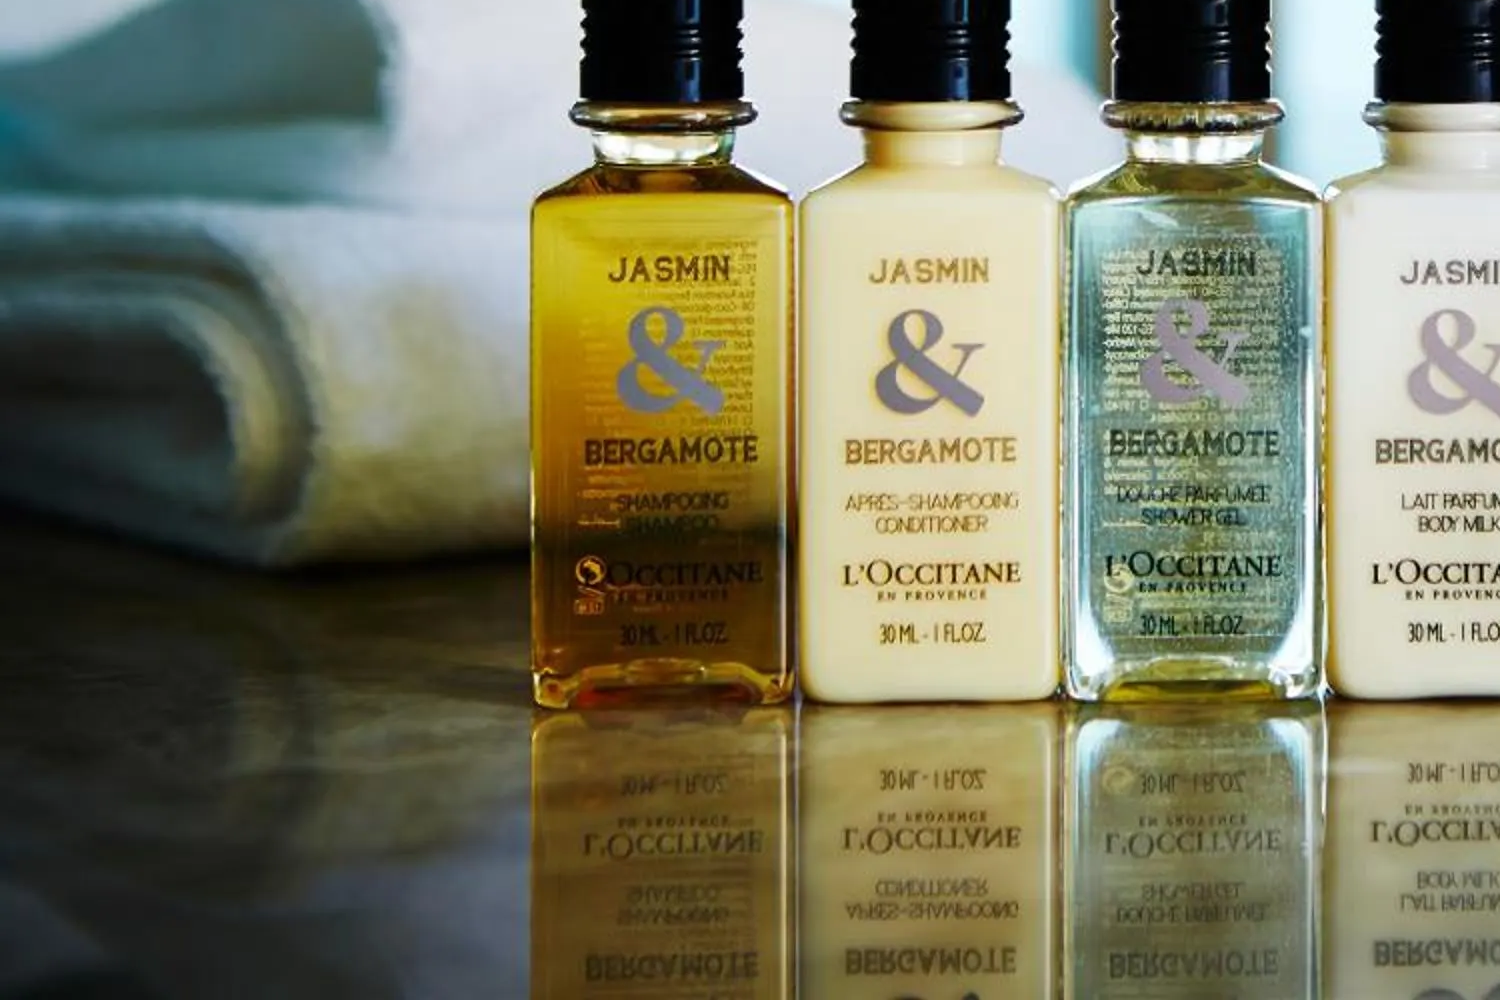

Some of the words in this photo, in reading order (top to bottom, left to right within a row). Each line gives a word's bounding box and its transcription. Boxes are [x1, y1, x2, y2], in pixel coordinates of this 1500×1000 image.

[608, 255, 730, 283] JASMIN
[868, 257, 989, 284] JASMIN
[1136, 249, 1257, 276] JASMIN
[616, 305, 726, 417] &
[875, 309, 985, 418] &
[1139, 299, 1251, 408] &
[584, 435, 759, 466] BERGAMOTE
[846, 437, 1017, 465] BERGAMOTE
[1109, 430, 1280, 457] BERGAMOTE
[1401, 492, 1439, 510] LAIT
[875, 515, 989, 534] CONDITIONER
[1141, 507, 1212, 526] SHOWER
[1216, 508, 1247, 526] GEL
[1418, 515, 1460, 533] BODY
[582, 559, 763, 587] OCCITANE
[843, 558, 1021, 587] L'OCCITANE
[1104, 550, 1282, 577] L'OCCITANE
[877, 590, 897, 601] EN
[905, 589, 987, 601] PROVENCE
[1405, 590, 1424, 601] EN
[880, 623, 896, 644] 30
[900, 622, 919, 644] ML
[1160, 615, 1181, 636] ML
[1408, 622, 1424, 643] 30
[1427, 622, 1447, 643] ML
